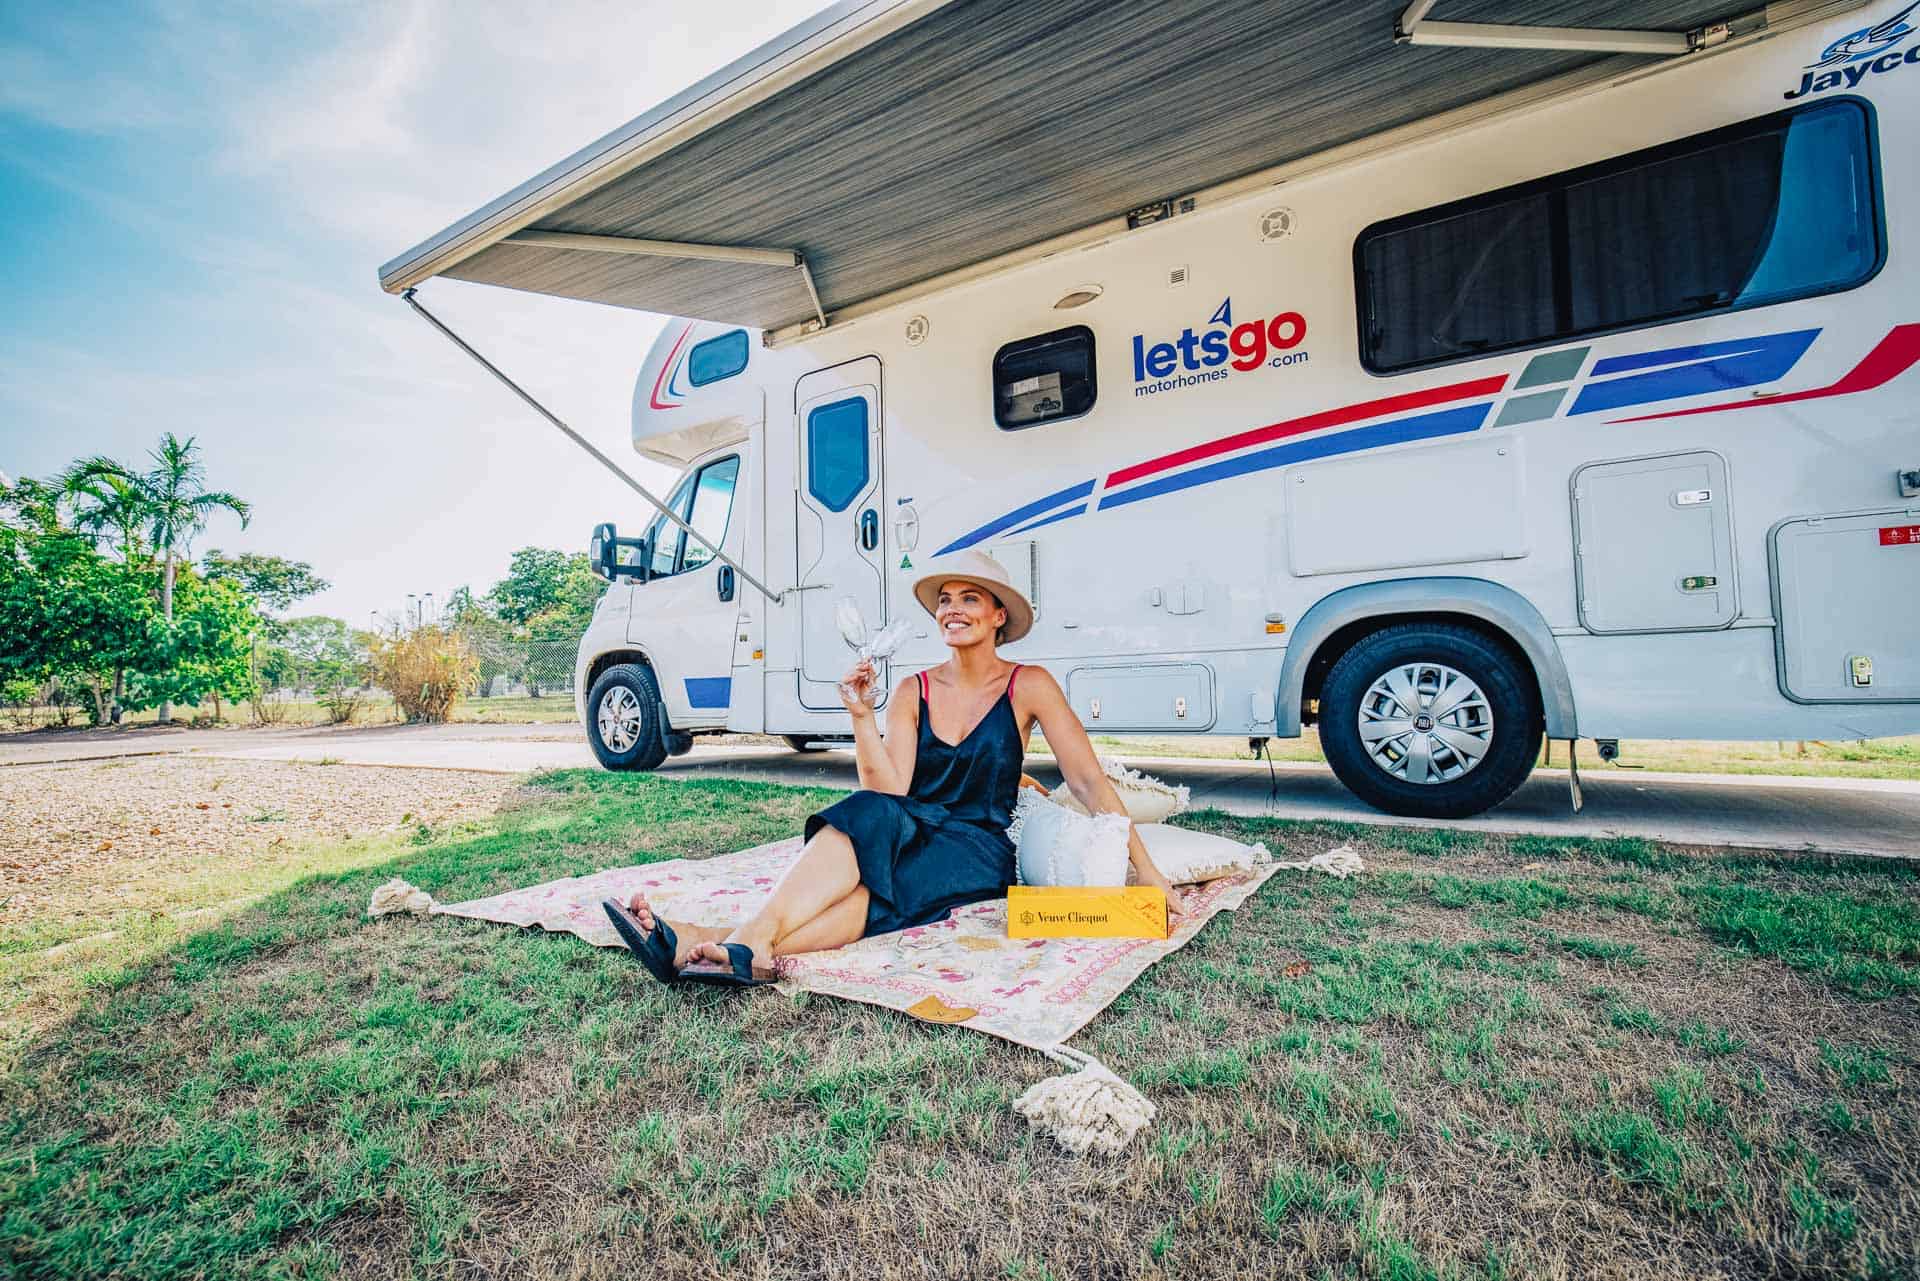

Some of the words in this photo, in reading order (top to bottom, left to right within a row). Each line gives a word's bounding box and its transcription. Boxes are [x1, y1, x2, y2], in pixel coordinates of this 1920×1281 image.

[1268, 351, 1309, 369] .com
[1135, 368, 1229, 397] motorhomes
[1038, 911, 1066, 923] Veuve
[1067, 911, 1108, 925] Clicquot
